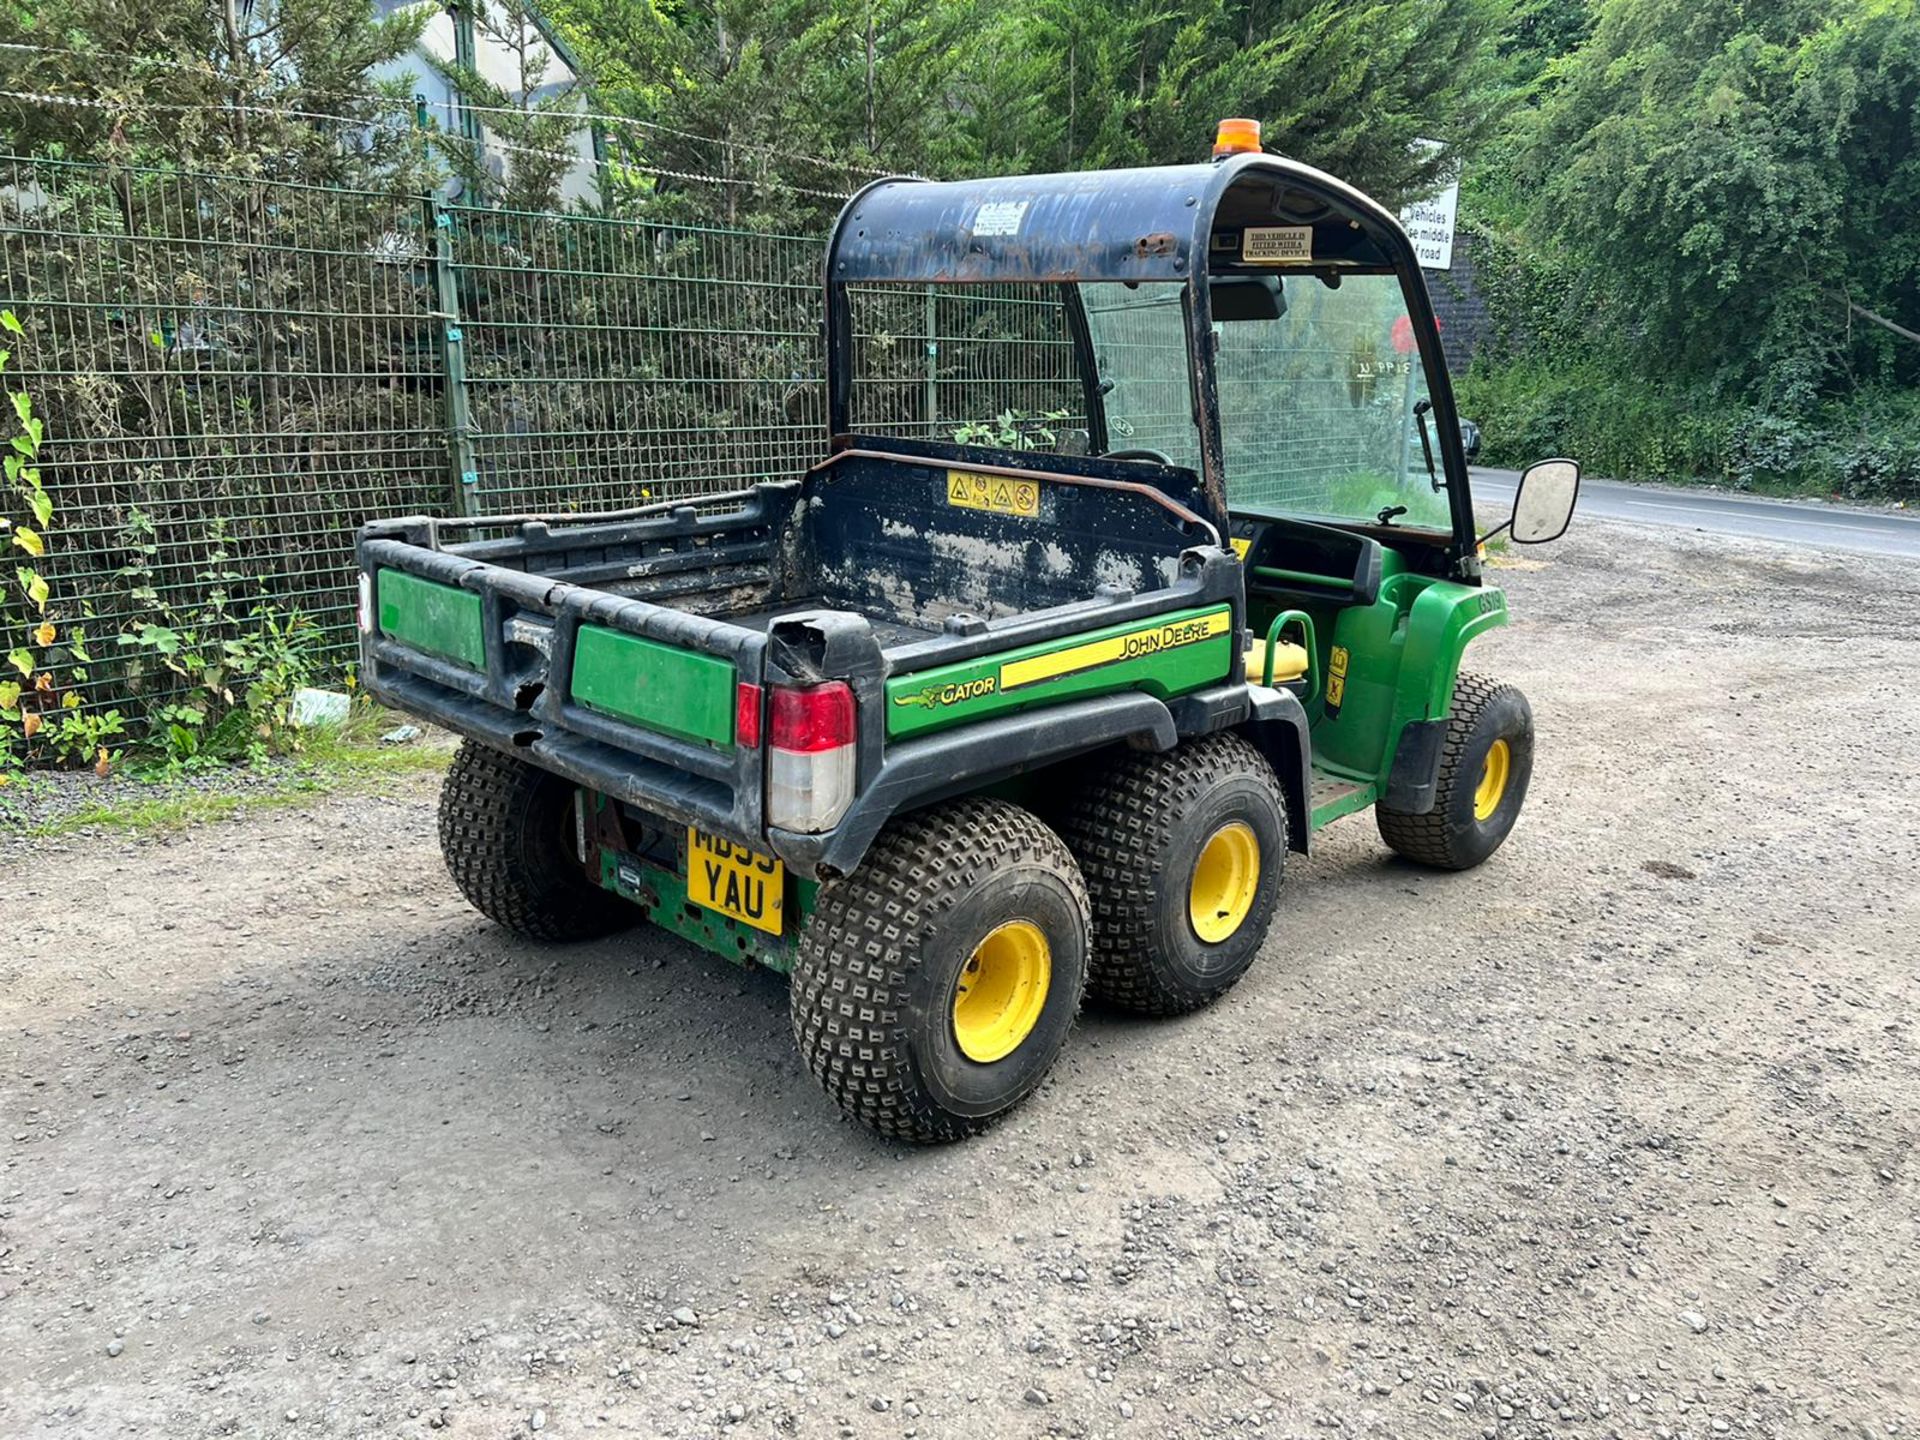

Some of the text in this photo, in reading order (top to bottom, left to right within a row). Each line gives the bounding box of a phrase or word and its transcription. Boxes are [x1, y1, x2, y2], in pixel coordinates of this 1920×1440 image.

[1251, 232, 1305, 240] THIS VEHICLE IS
[1420, 228, 1450, 243] middle
[1252, 241, 1276, 249] FITTED
[1277, 241, 1297, 249] WITH
[1245, 250, 1279, 258] TRACKING
[1420, 247, 1441, 260] road
[1119, 621, 1210, 658] JOHN DEERE
[940, 676, 996, 704] GATOR
[704, 859, 764, 920] YAU
